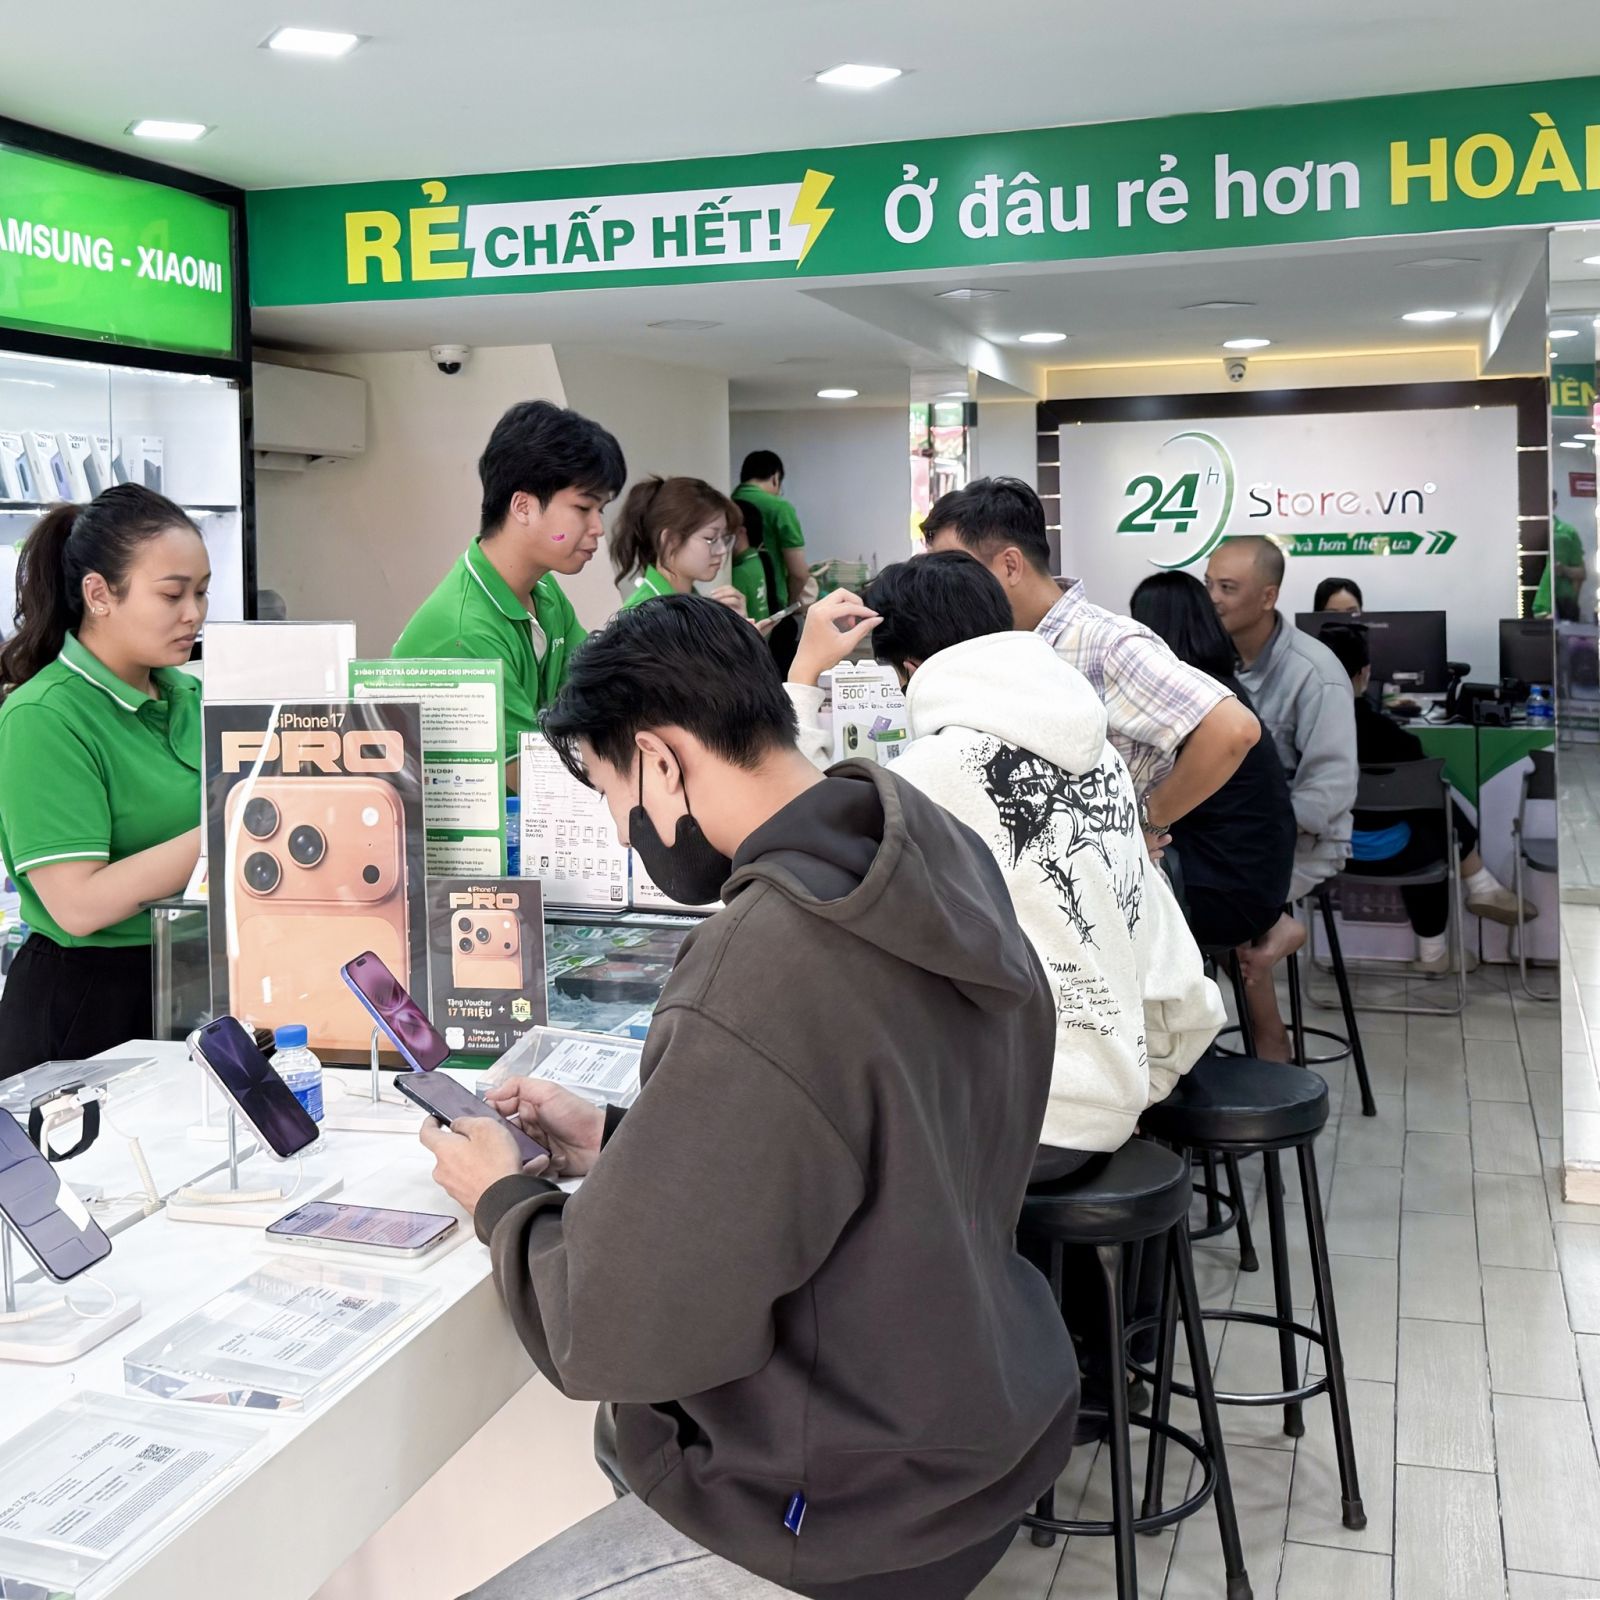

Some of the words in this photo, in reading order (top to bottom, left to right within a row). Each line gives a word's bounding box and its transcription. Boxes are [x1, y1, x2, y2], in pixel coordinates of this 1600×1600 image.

[884, 164, 938, 244] Ở
[957, 172, 1091, 239] đâu
[1116, 154, 1189, 228] rẻ
[1214, 153, 1360, 220] hơn
[345, 180, 468, 285] RẺ
[484, 204, 635, 268] CHẤP
[652, 195, 782, 259] HẾT!
[136, 247, 222, 293] XIAOMI
[1249, 484, 1424, 518] Store.vn
[1318, 537, 1347, 551] hơn
[280, 713, 329, 729] iPhone
[329, 713, 345, 729] 17
[221, 730, 405, 773] PRO
[449, 892, 520, 910] PRO
[448, 1007, 458, 1017] 17
[460, 1006, 493, 1019] TRIỆU
[465, 999, 492, 1008] Voucher
